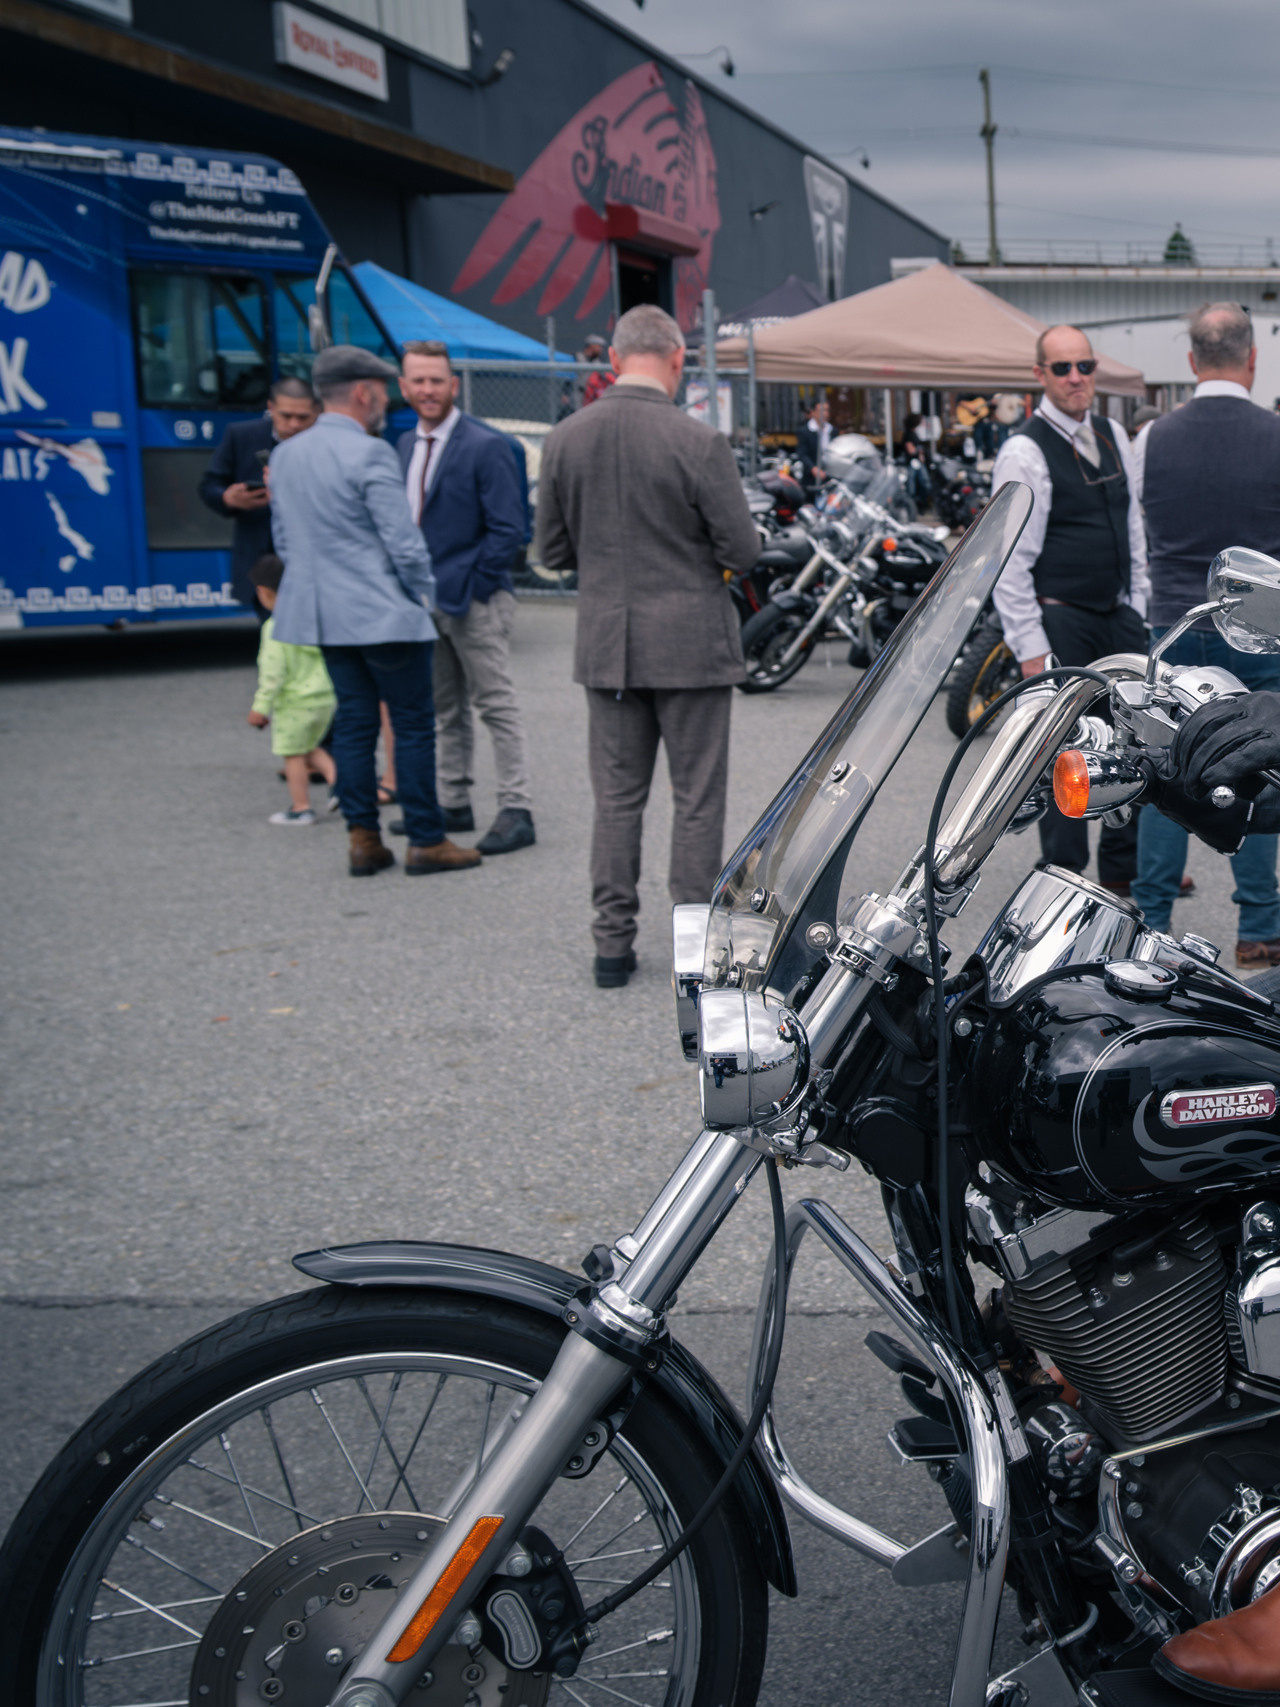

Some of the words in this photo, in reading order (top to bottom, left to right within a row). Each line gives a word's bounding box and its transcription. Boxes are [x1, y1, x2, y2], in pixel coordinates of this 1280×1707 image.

[571, 115, 666, 221] Indian
[0, 447, 53, 482] ATS
[1179, 1103, 1270, 1121] DAVIDSON
[1188, 1093, 1265, 1110] HARLEY-
